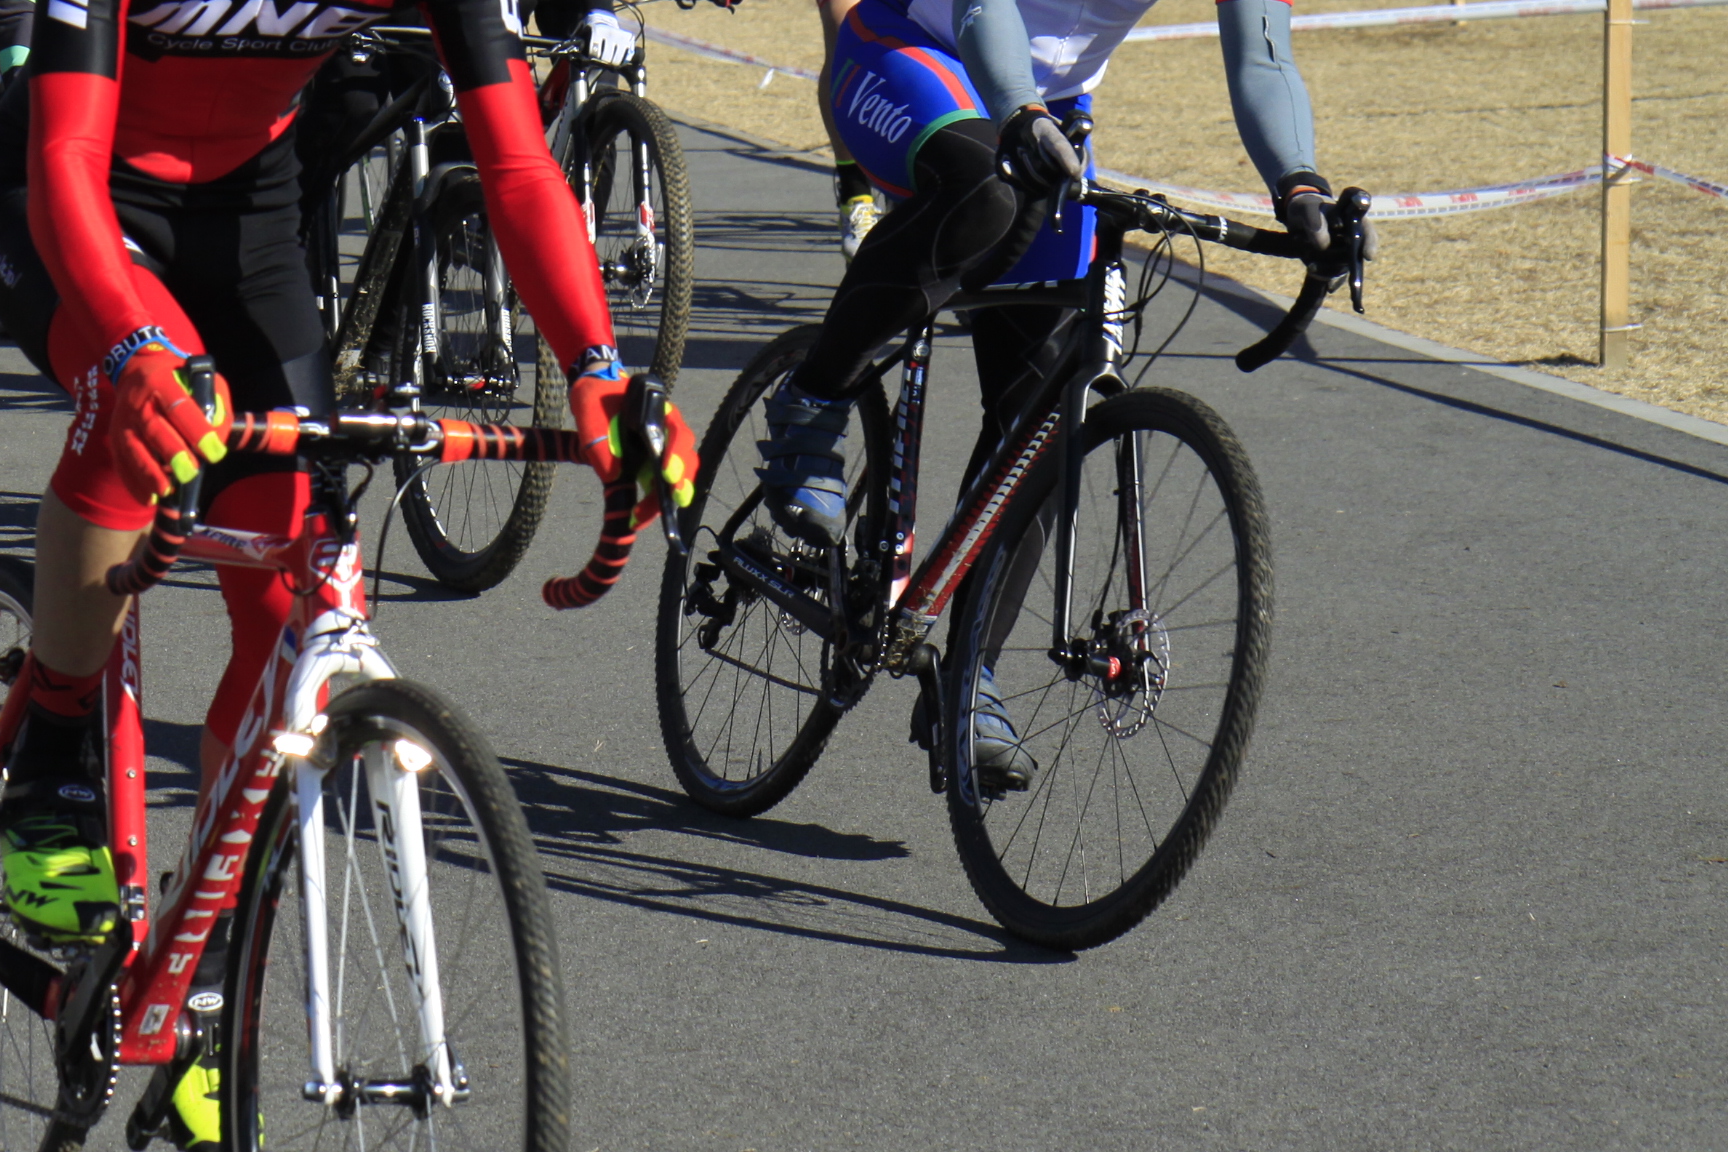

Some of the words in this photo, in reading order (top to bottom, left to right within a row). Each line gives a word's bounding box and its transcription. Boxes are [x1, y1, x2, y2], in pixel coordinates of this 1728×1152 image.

[147, 34, 214, 52] Cycle
[220, 36, 282, 52] Sport
[847, 70, 913, 144] Vento
